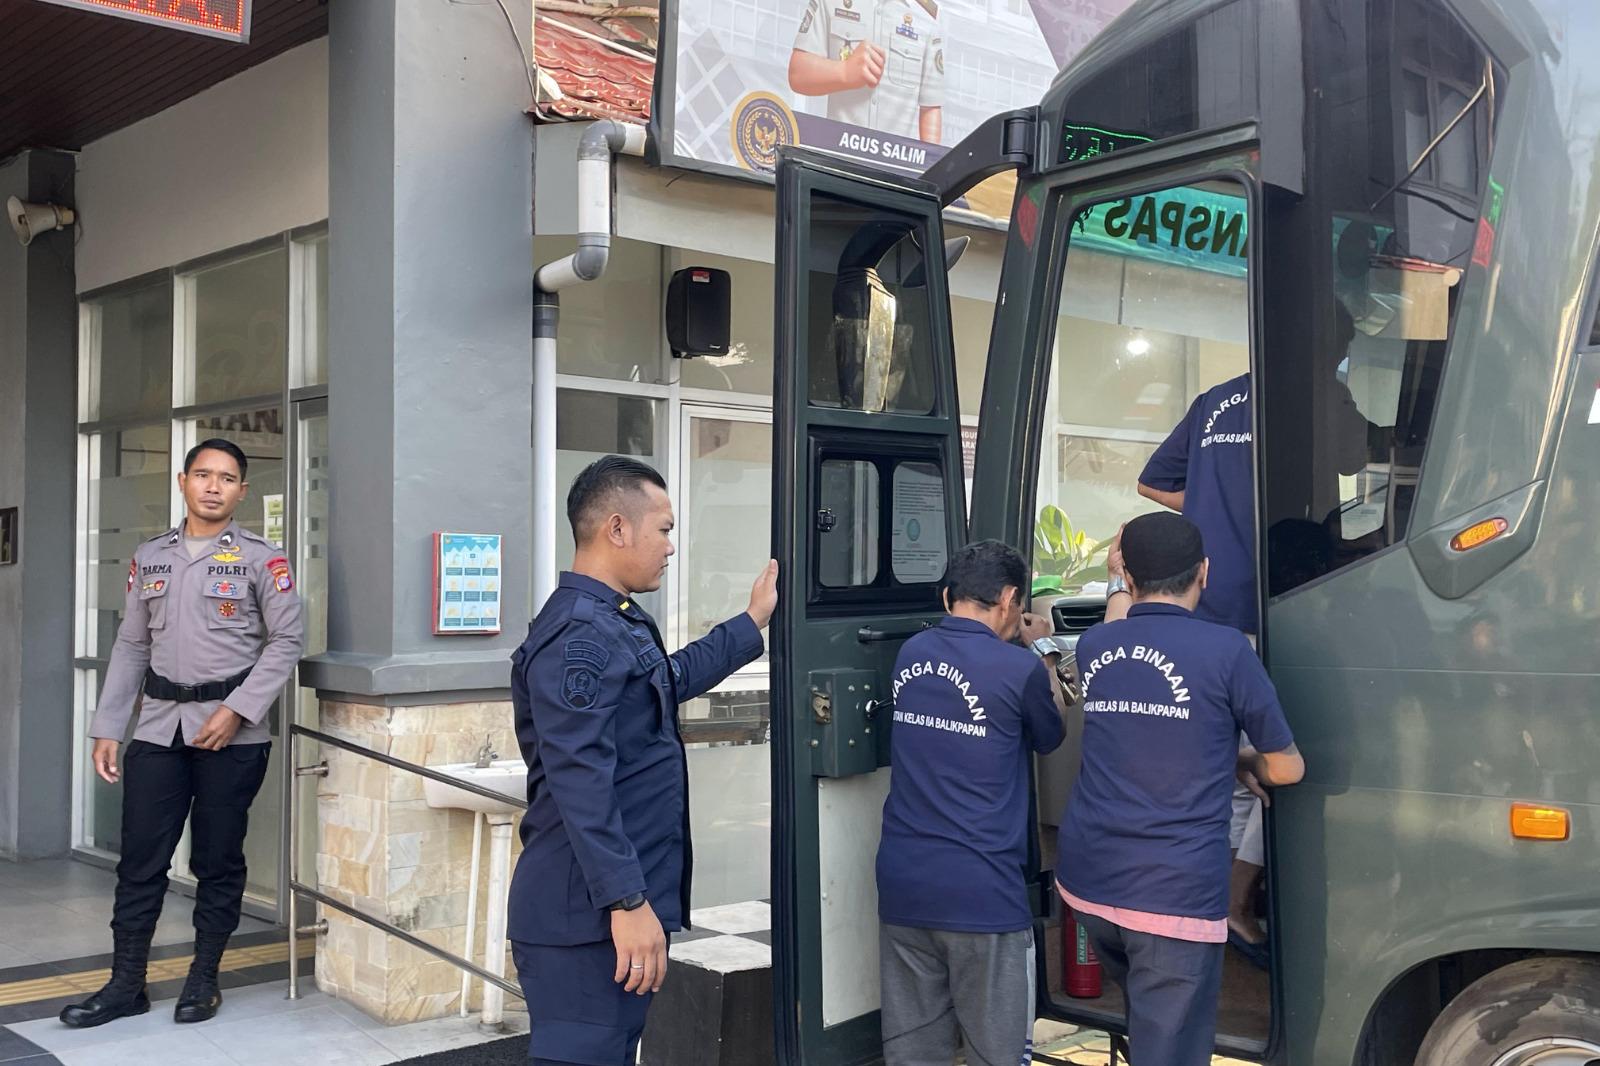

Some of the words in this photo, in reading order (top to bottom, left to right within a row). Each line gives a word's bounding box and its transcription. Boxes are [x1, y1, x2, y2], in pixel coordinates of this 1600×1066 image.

[839, 132, 880, 155] AGUS
[882, 141, 926, 165] SALIM
[142, 564, 173, 577] DARMA
[207, 565, 248, 576] POLRI
[1081, 646, 1127, 698] WARGA
[1131, 645, 1191, 703] BINAAN
[936, 661, 987, 721] BINAAN
[1095, 700, 1118, 713] KELAS
[1131, 701, 1190, 720] BALIKPAPAN
[904, 711, 925, 727] KELAS
[935, 717, 987, 738] BALIKPAPAN
